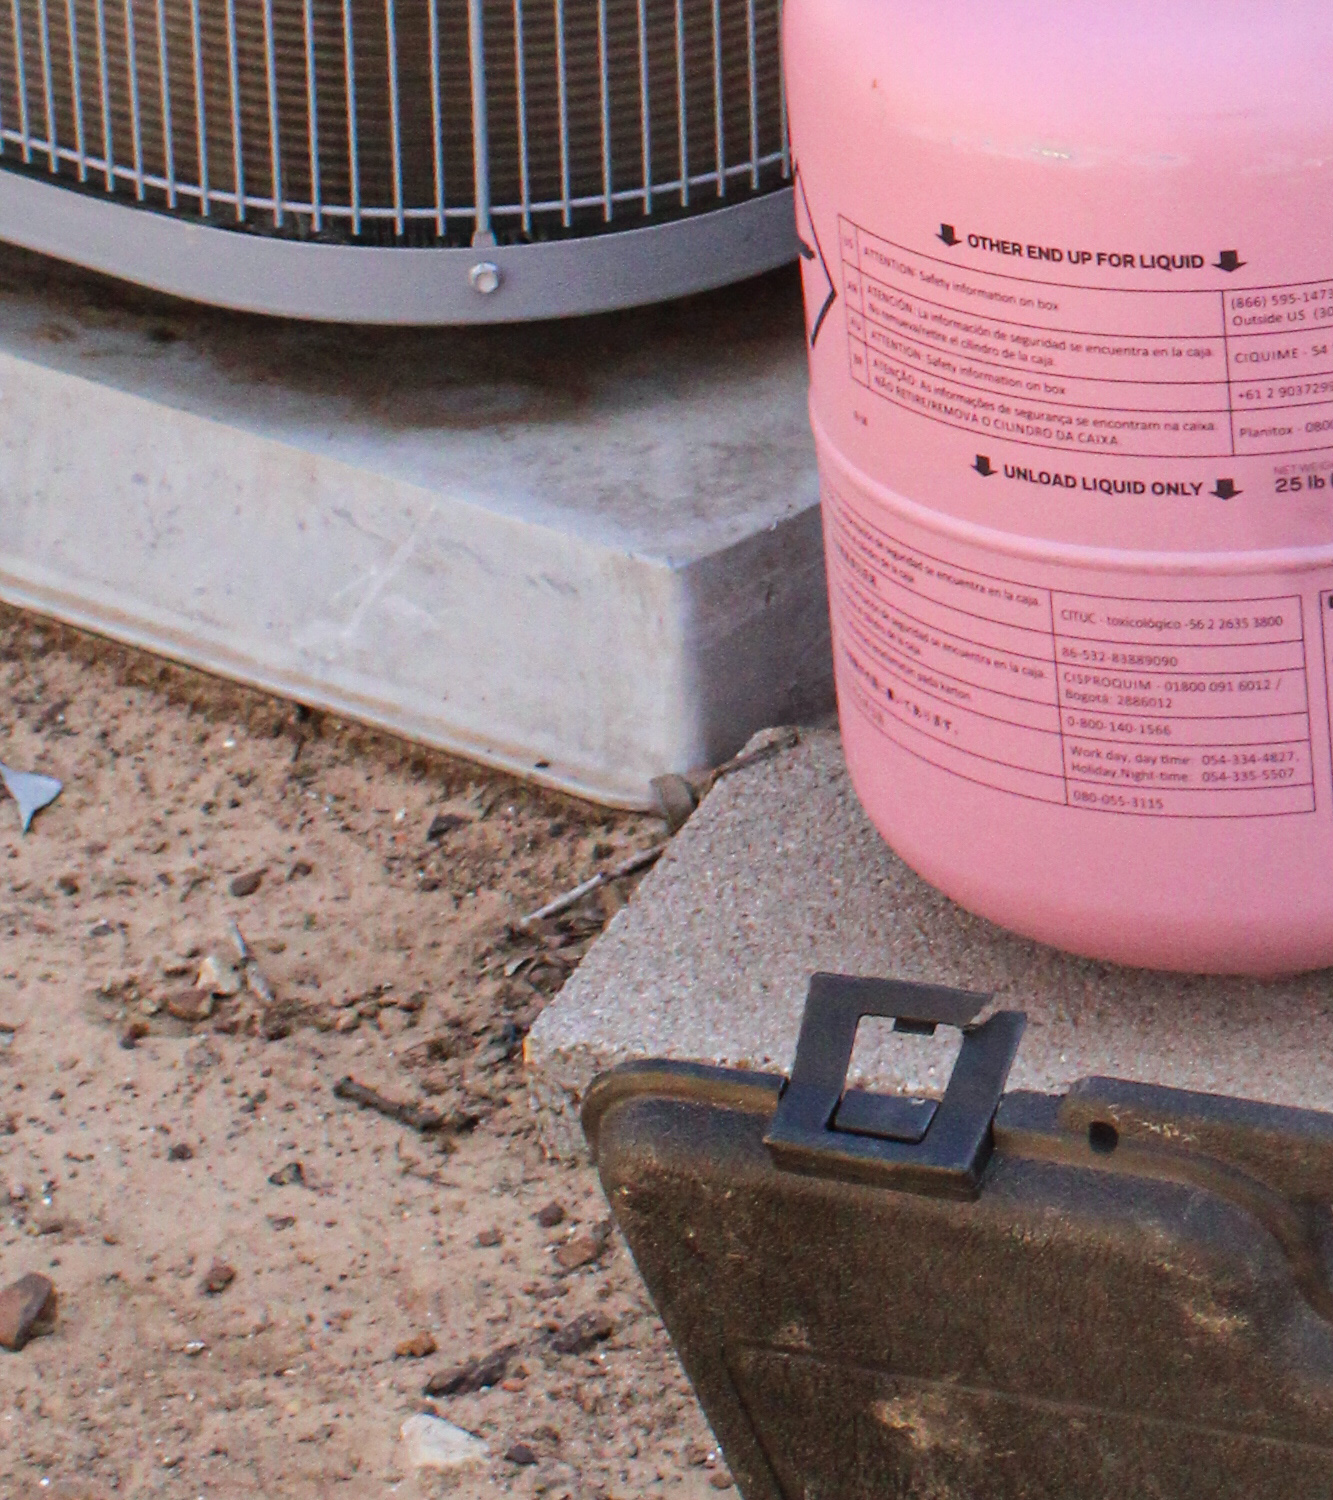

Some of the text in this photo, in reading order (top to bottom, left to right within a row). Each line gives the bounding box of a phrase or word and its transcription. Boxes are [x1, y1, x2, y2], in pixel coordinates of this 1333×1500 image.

[967, 233, 1204, 271] OTHER END UP FOR LIQUID
[919, 269, 950, 292] Safety
[953, 278, 1016, 305] information
[1020, 296, 1034, 308] on
[1037, 296, 1058, 311] box
[1231, 295, 1267, 310] (866)
[1232, 311, 1283, 327] Outside
[1287, 309, 1306, 321] US
[930, 309, 990, 341] información
[993, 330, 1006, 342] de
[1010, 332, 1066, 354] seguridad
[1070, 342, 1082, 353] se
[1085, 343, 1149, 358] encuentra
[1153, 348, 1168, 357] en
[1172, 344, 1182, 357] la
[1002, 345, 1017, 359] de
[1234, 347, 1298, 365] CIQUIME
[1311, 344, 1327, 357] 54
[926, 352, 956, 375] Safety
[959, 362, 1023, 389] information
[1026, 380, 1040, 392] on
[1044, 380, 1066, 396] box
[1238, 389, 1262, 401] +61
[1267, 387, 1274, 399] 2
[997, 400, 1011, 415] de
[1014, 406, 1072, 429] segurança
[1076, 415, 1089, 427] se
[1092, 417, 1160, 433] encontram
[1164, 422, 1180, 432] na
[994, 416, 1052, 440] CILINDRO
[1056, 426, 1074, 441] DA
[1239, 423, 1293, 439] Planitox
[1273, 463, 1301, 475] NET
[1004, 463, 1203, 497] UNLOAD LIQUID ONLY
[1275, 476, 1303, 493] 25
[1308, 473, 1325, 489] lb
[937, 570, 986, 593] encuentra
[988, 586, 1000, 597] en
[1004, 589, 1014, 601] la
[1061, 609, 1095, 624] CITUC
[1107, 616, 1181, 632] toxicológico
[1207, 619, 1214, 629] 2
[1219, 618, 1248, 629] 2635
[1254, 616, 1283, 627] 3800
[993, 659, 1007, 670] en
[1010, 662, 1019, 673] la
[1063, 671, 1151, 690] CISPROQUIM
[1164, 681, 1205, 692] 01800
[1210, 681, 1233, 691] 091
[1238, 679, 1271, 690] 6012
[1117, 694, 1173, 708] 2886012
[1066, 716, 1171, 736] 0-800-140-1566
[1070, 746, 1102, 759] Work
[1136, 752, 1157, 765] day
[1202, 769, 1294, 782] 054-335-5507
[1073, 790, 1164, 809] 080-055-3115
